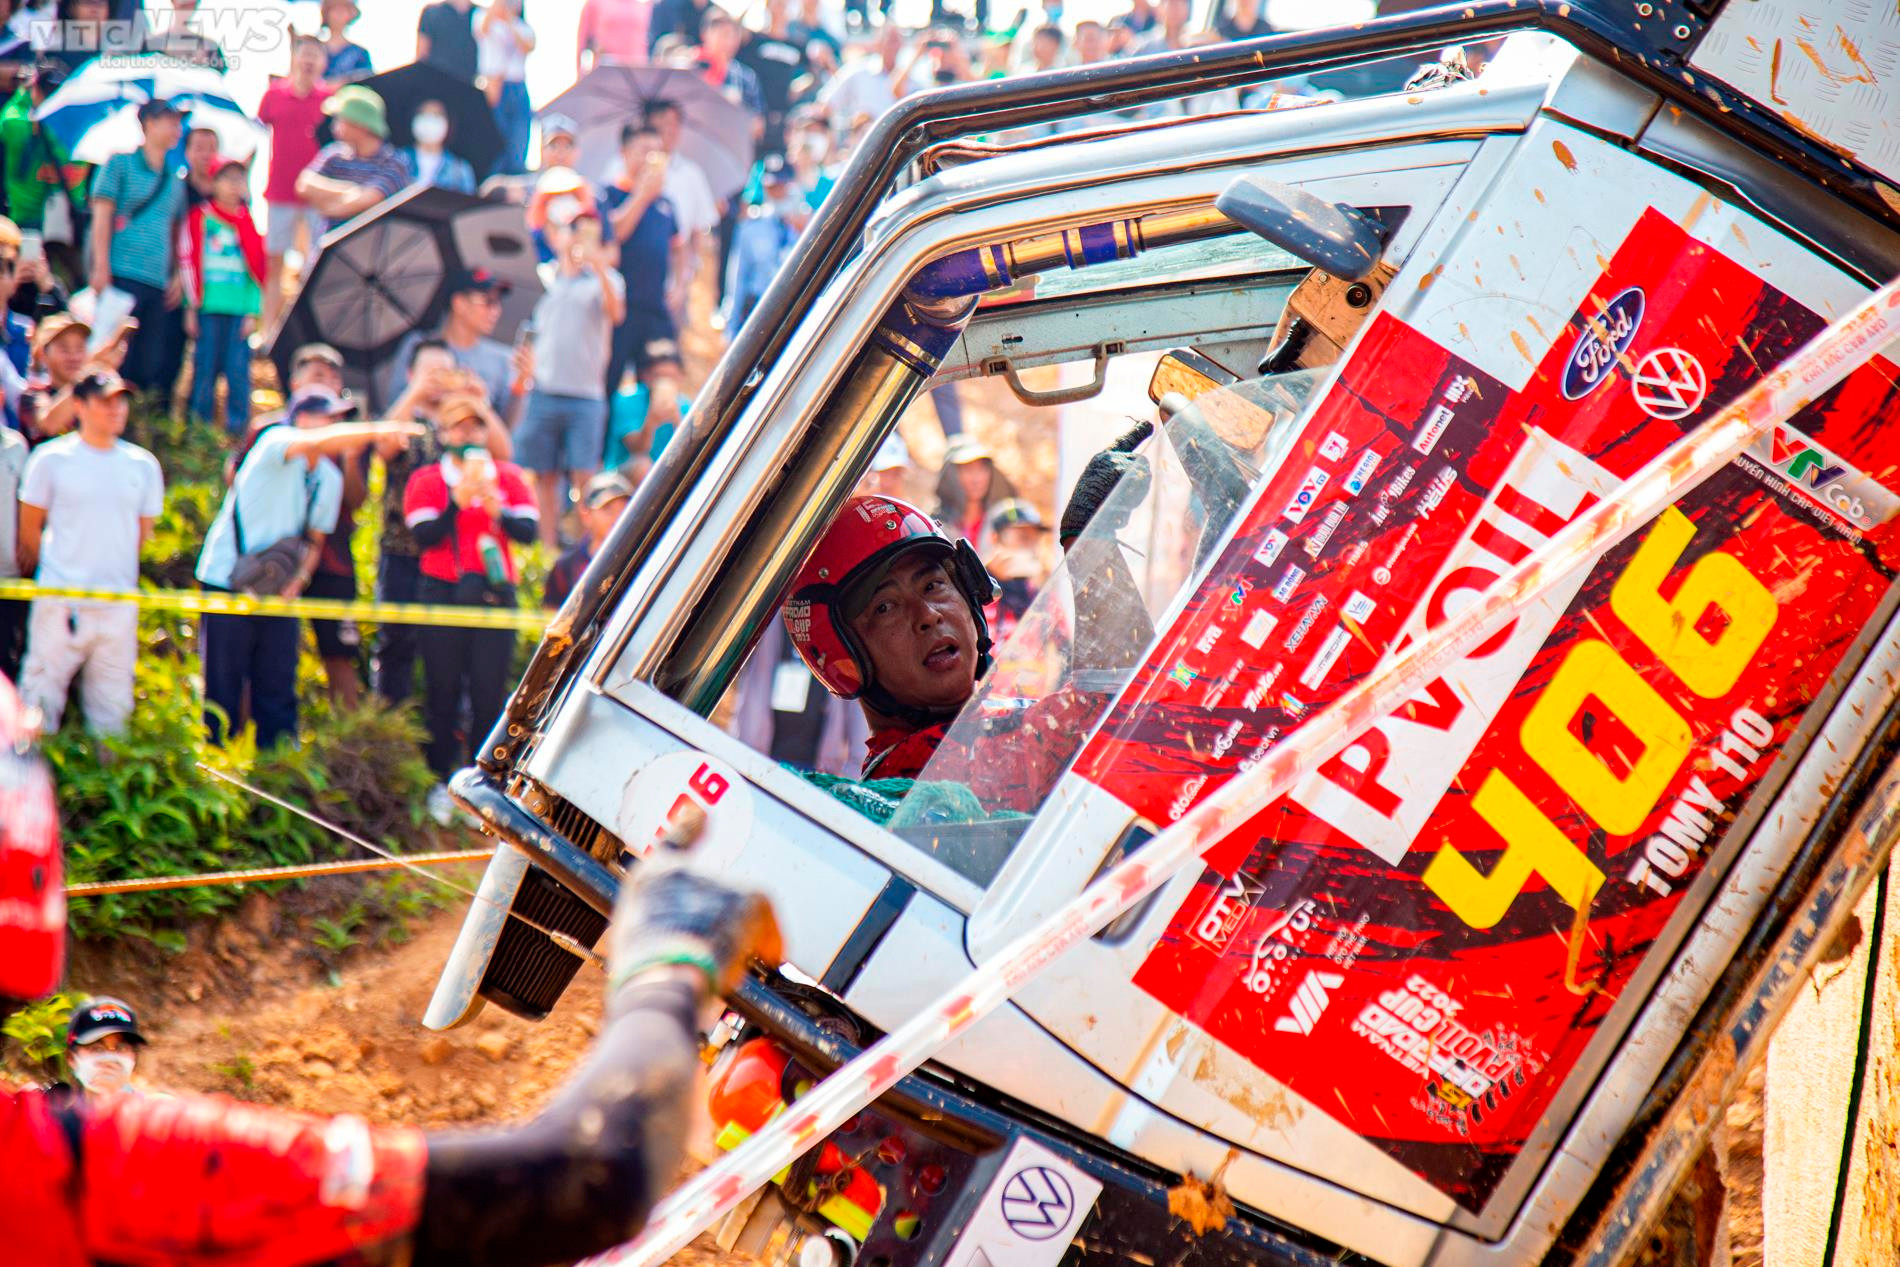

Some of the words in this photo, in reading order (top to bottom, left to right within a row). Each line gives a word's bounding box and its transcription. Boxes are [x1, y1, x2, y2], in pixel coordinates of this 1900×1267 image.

[1575, 306, 1634, 383] Ford
[1417, 409, 1450, 451] Autonet
[1287, 477, 1321, 517] VOV
[1421, 504, 1778, 928] 406
[1627, 776, 1726, 897] TOMY
[1711, 708, 1775, 781] 110
[1210, 881, 1264, 950] MEDIA
[1374, 979, 1443, 1037] CUP
[1403, 971, 1465, 1019] 2022
[1347, 1018, 1433, 1080] VIETNAM
[1355, 999, 1493, 1100] OFFROAD
